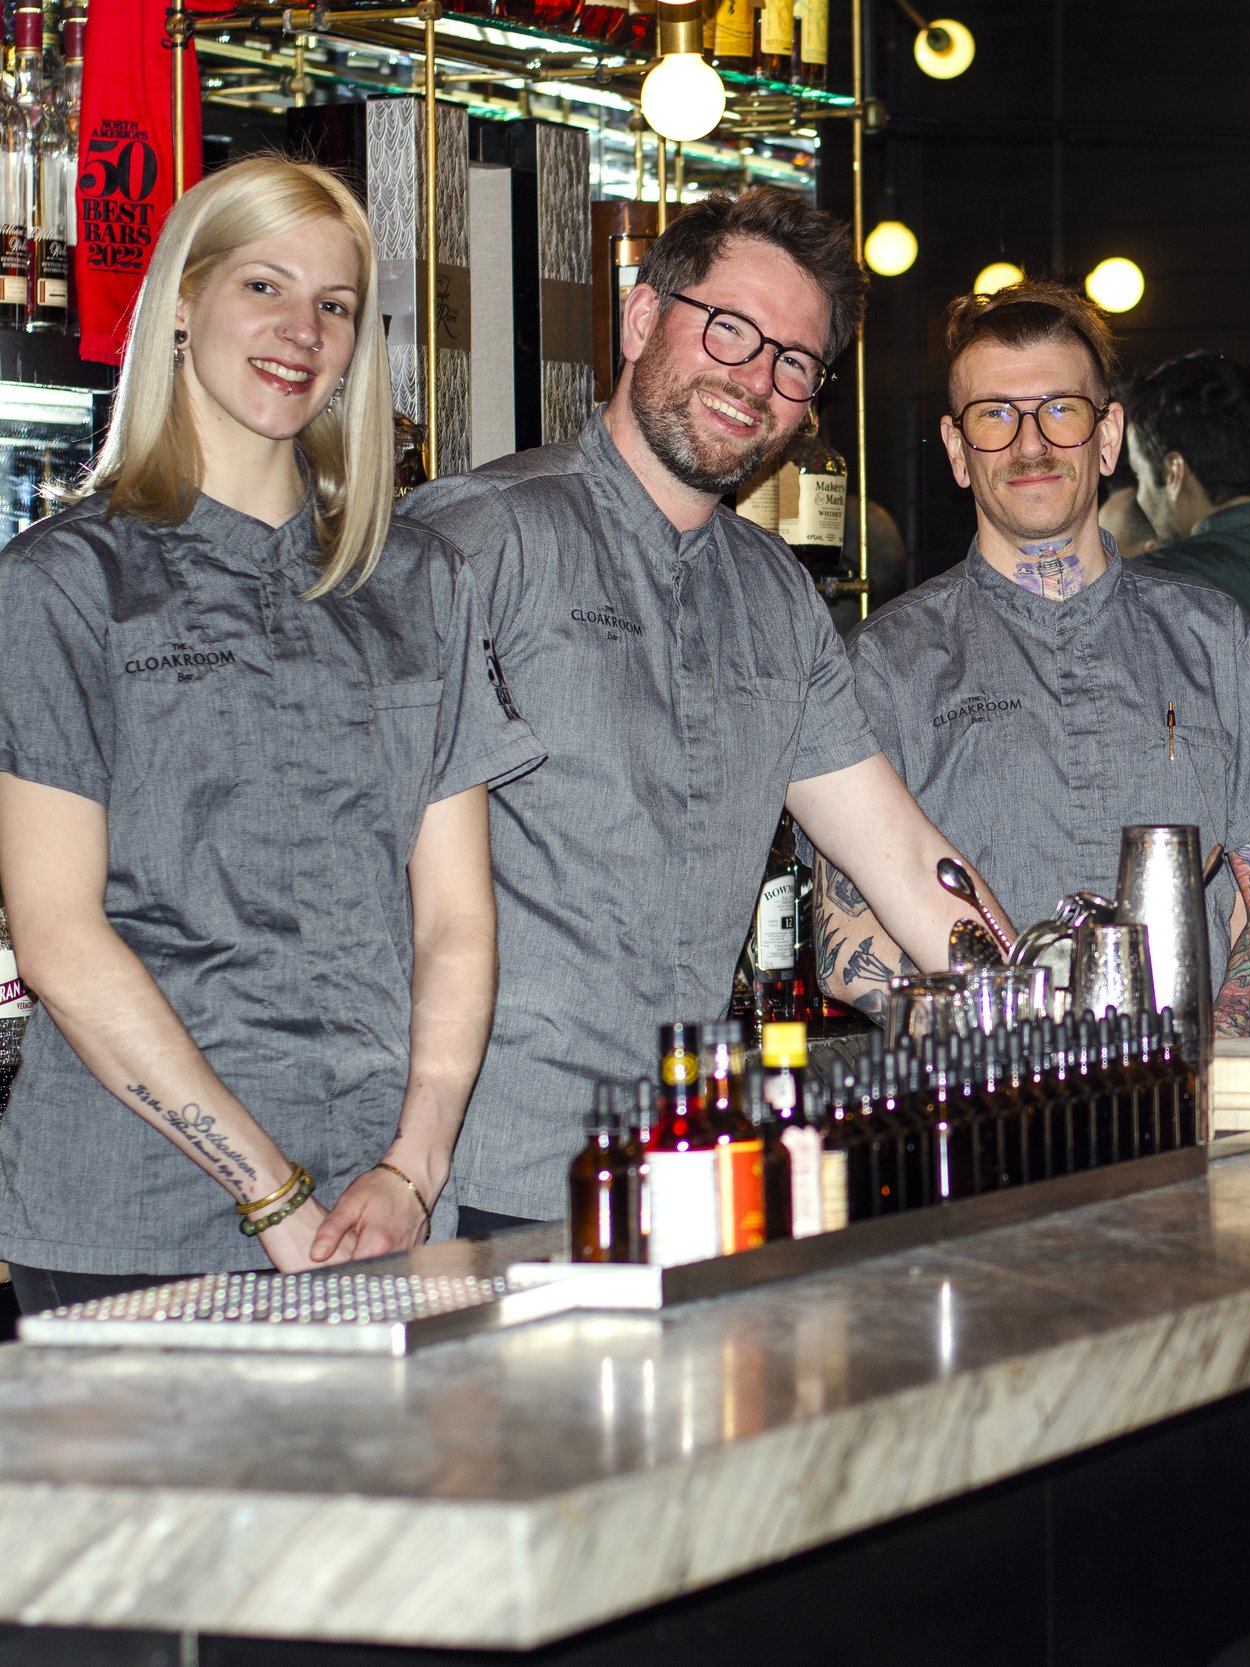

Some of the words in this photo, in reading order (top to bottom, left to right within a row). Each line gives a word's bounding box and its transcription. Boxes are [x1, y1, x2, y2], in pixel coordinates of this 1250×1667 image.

[92, 128, 149, 140] AMERICA'S
[102, 120, 139, 130] NORTH
[79, 139, 158, 202] 50
[82, 198, 154, 225] BEST
[84, 222, 151, 246] BARS
[88, 244, 143, 269] 2022
[571, 609, 643, 637] CLOAKROOM
[125, 650, 236, 674] CLOAKROOM
[933, 699, 1022, 728] CLOAKROOM
[785, 917, 793, 929] 12
